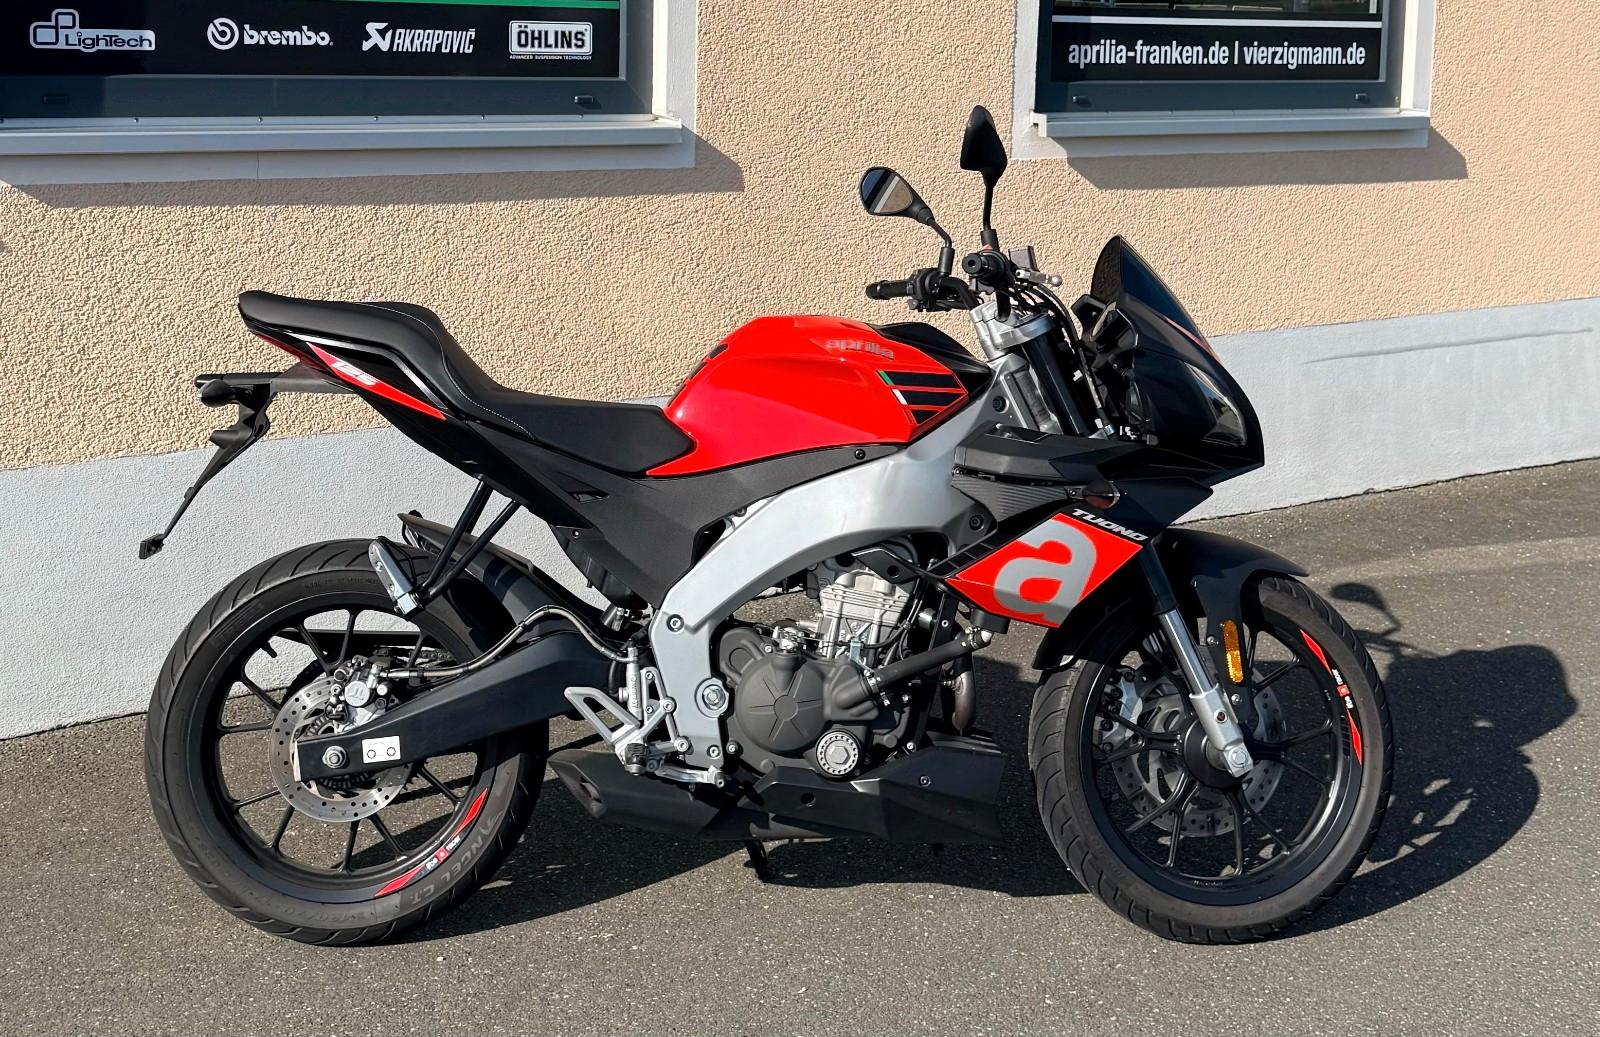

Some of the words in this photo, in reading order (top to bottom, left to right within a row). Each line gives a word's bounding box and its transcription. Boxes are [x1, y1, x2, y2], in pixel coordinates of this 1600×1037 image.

[65, 31, 153, 50] LighTech
[517, 24, 588, 49] ÖHLINS
[1068, 39, 1229, 68] aprilia-franken.de
[1243, 41, 1366, 70] vierzigmann.de
[1071, 508, 1149, 542] TUONO
